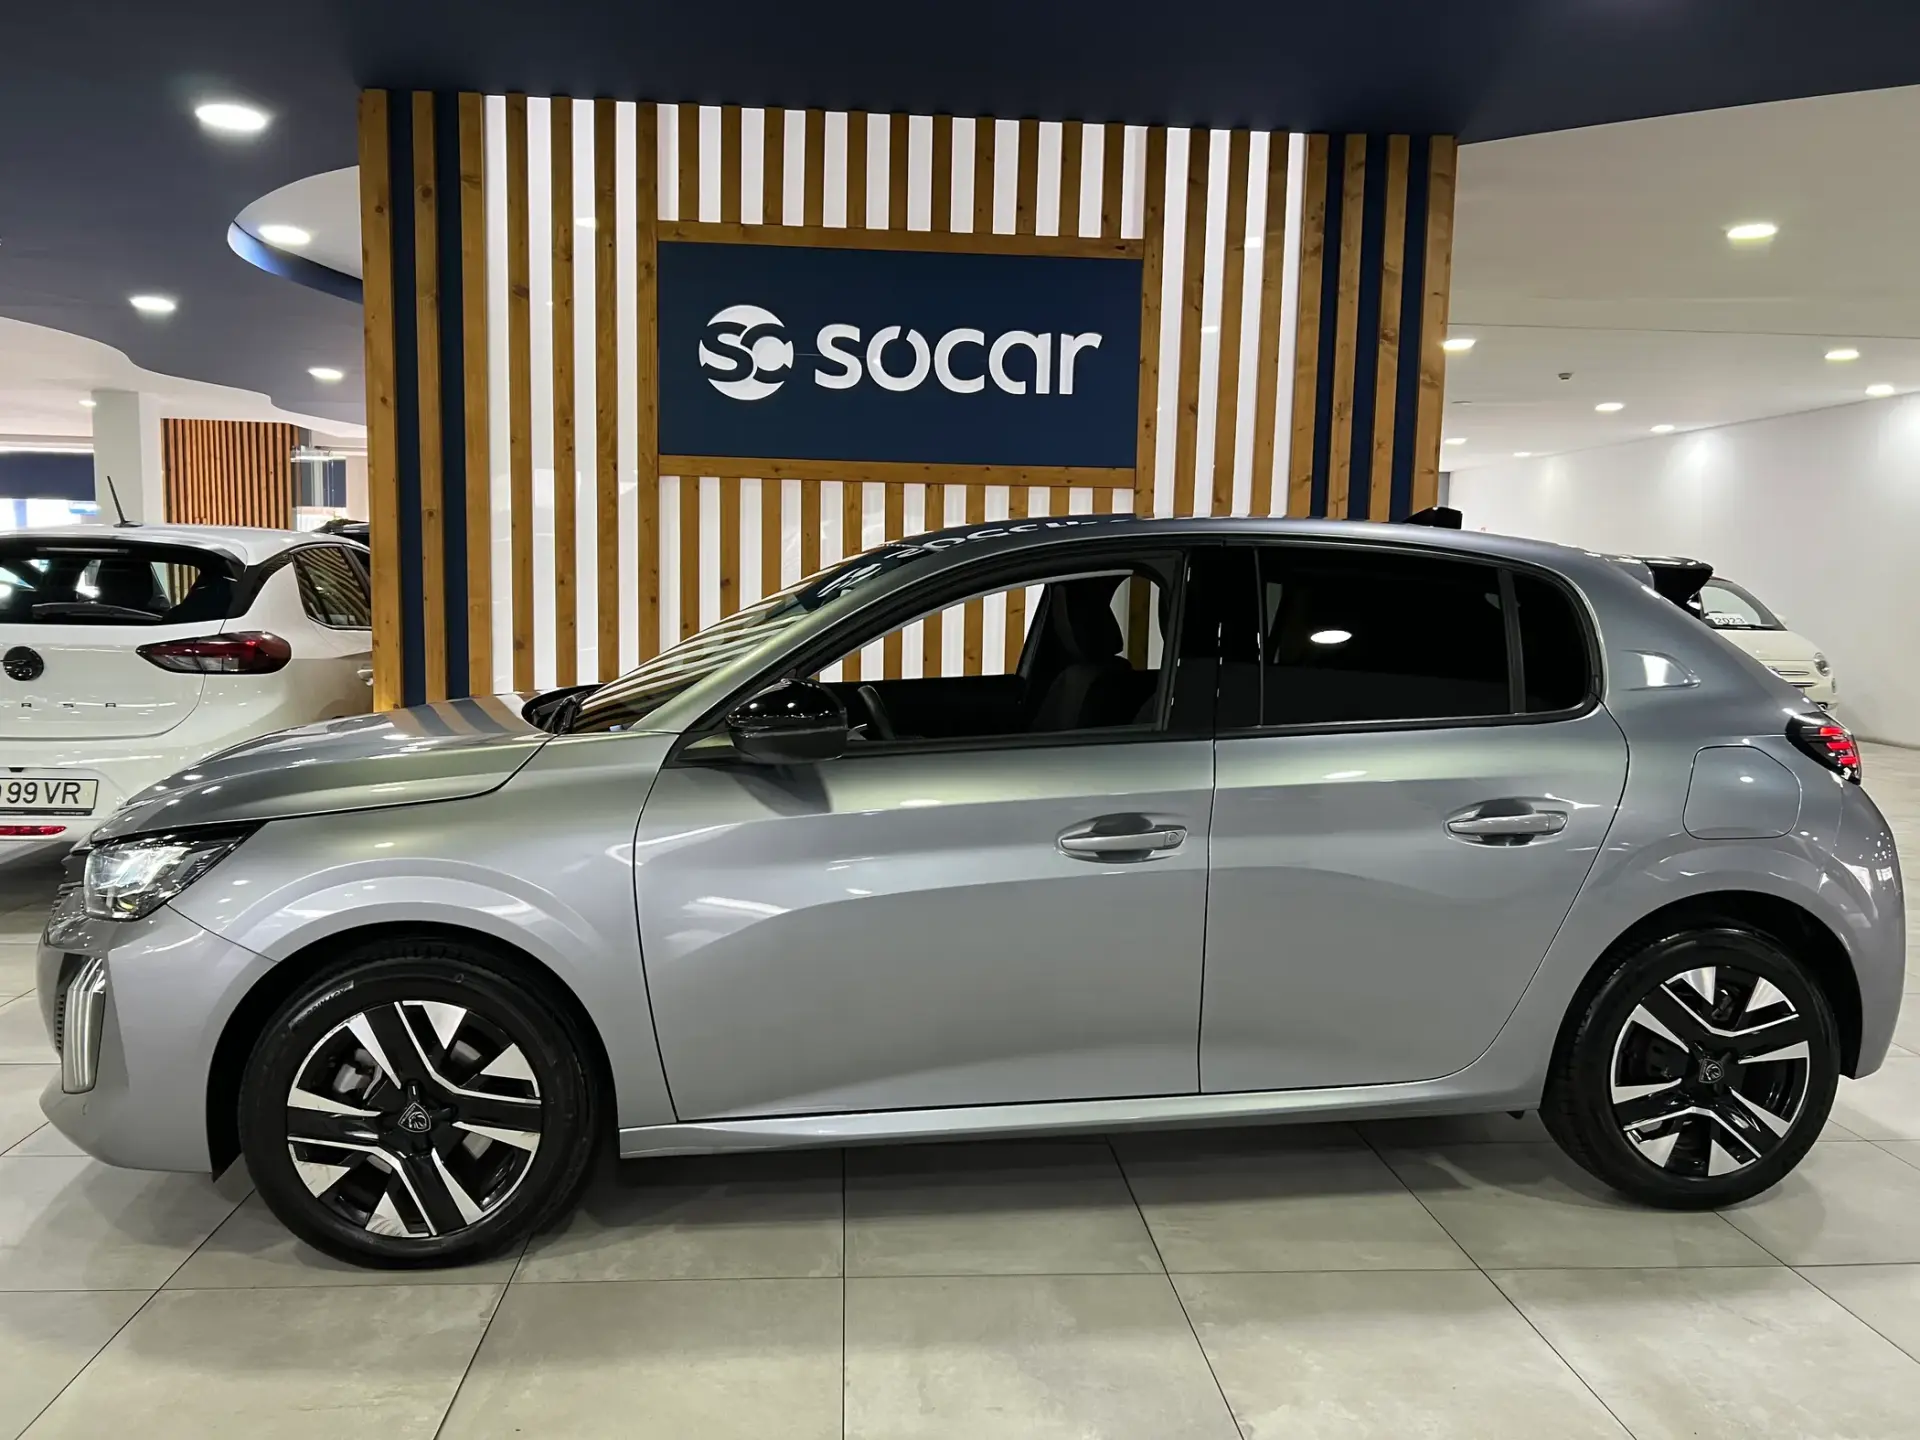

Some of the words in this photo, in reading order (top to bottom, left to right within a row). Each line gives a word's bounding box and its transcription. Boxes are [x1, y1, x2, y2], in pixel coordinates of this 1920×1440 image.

[1714, 617, 1745, 625] 2023
[6, 782, 38, 804] 99
[44, 782, 81, 804] VR
